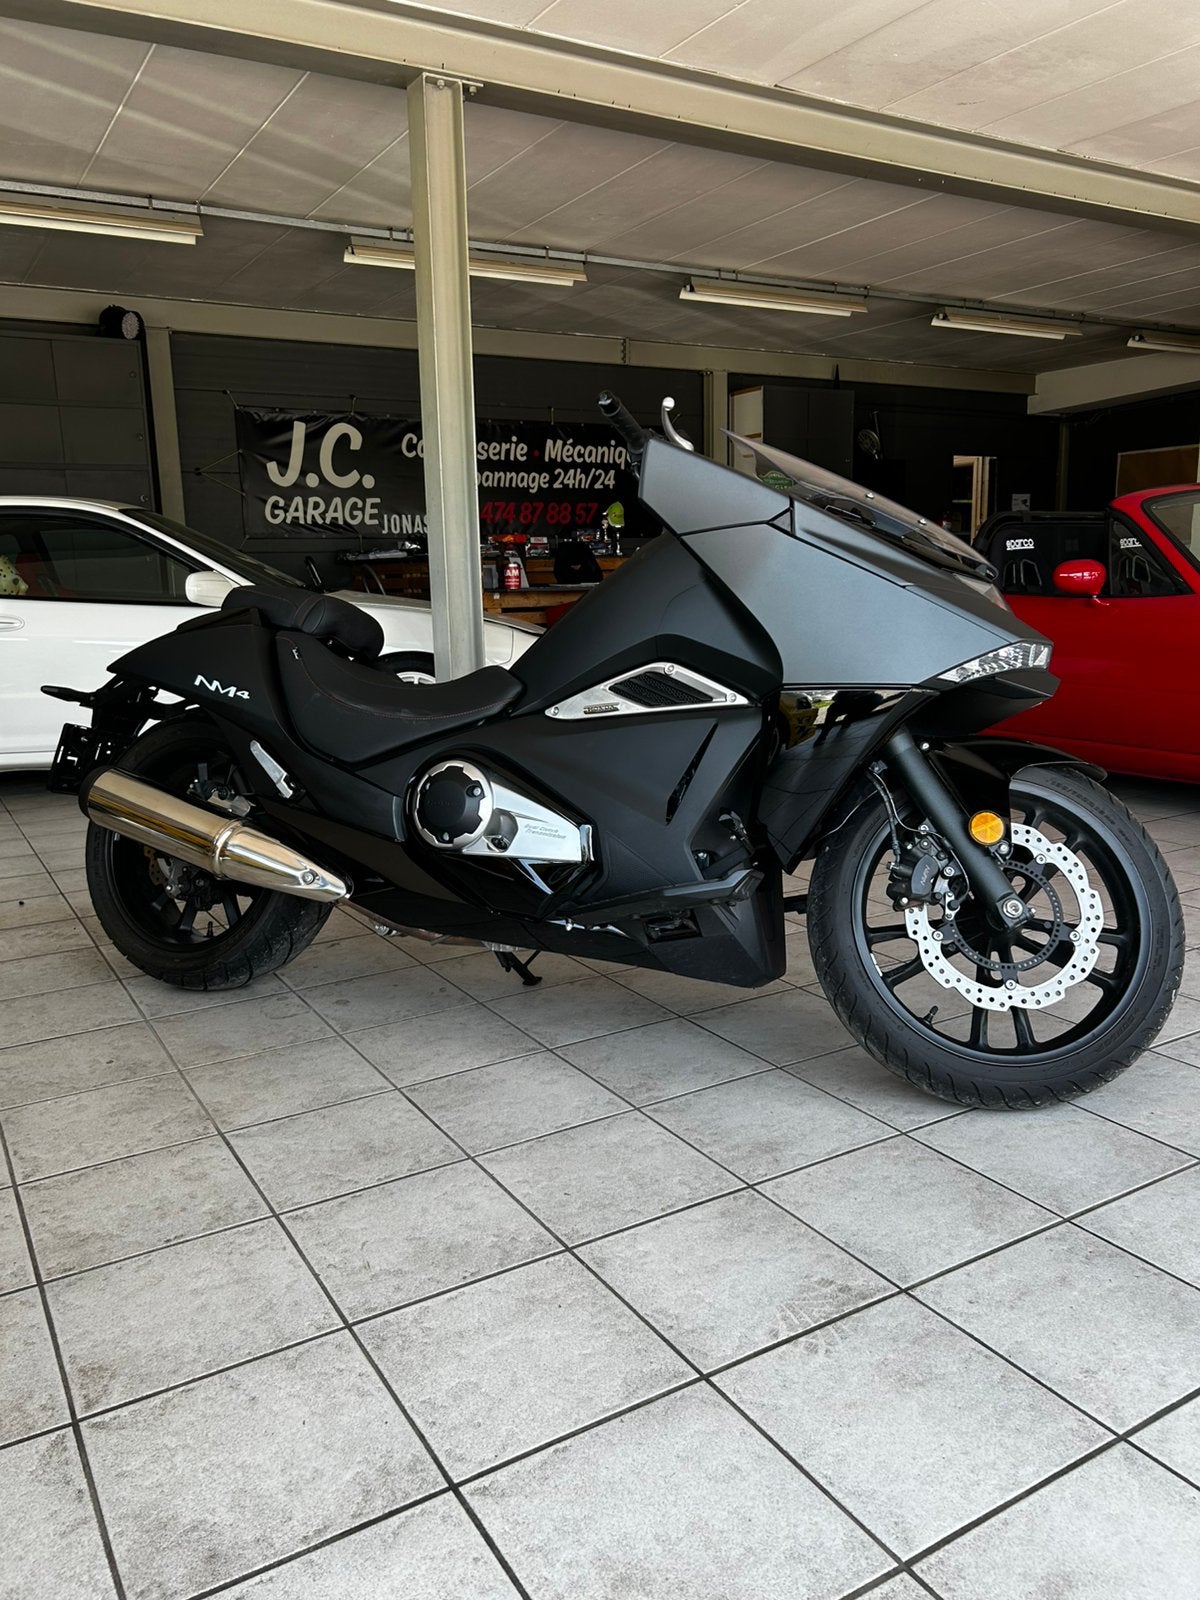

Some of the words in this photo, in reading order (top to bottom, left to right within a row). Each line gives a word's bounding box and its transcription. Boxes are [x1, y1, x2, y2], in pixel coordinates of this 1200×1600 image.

[266, 421, 375, 489] J.C.
[544, 438, 631, 471] Mécaniq
[553, 468, 616, 490] 24h/24
[264, 496, 381, 525] GARAGE
[520, 503, 544, 525] 87
[546, 503, 572, 525] 88
[574, 503, 597, 524] 57
[1006, 538, 1034, 550] sparco
[194, 674, 250, 699] NM4
